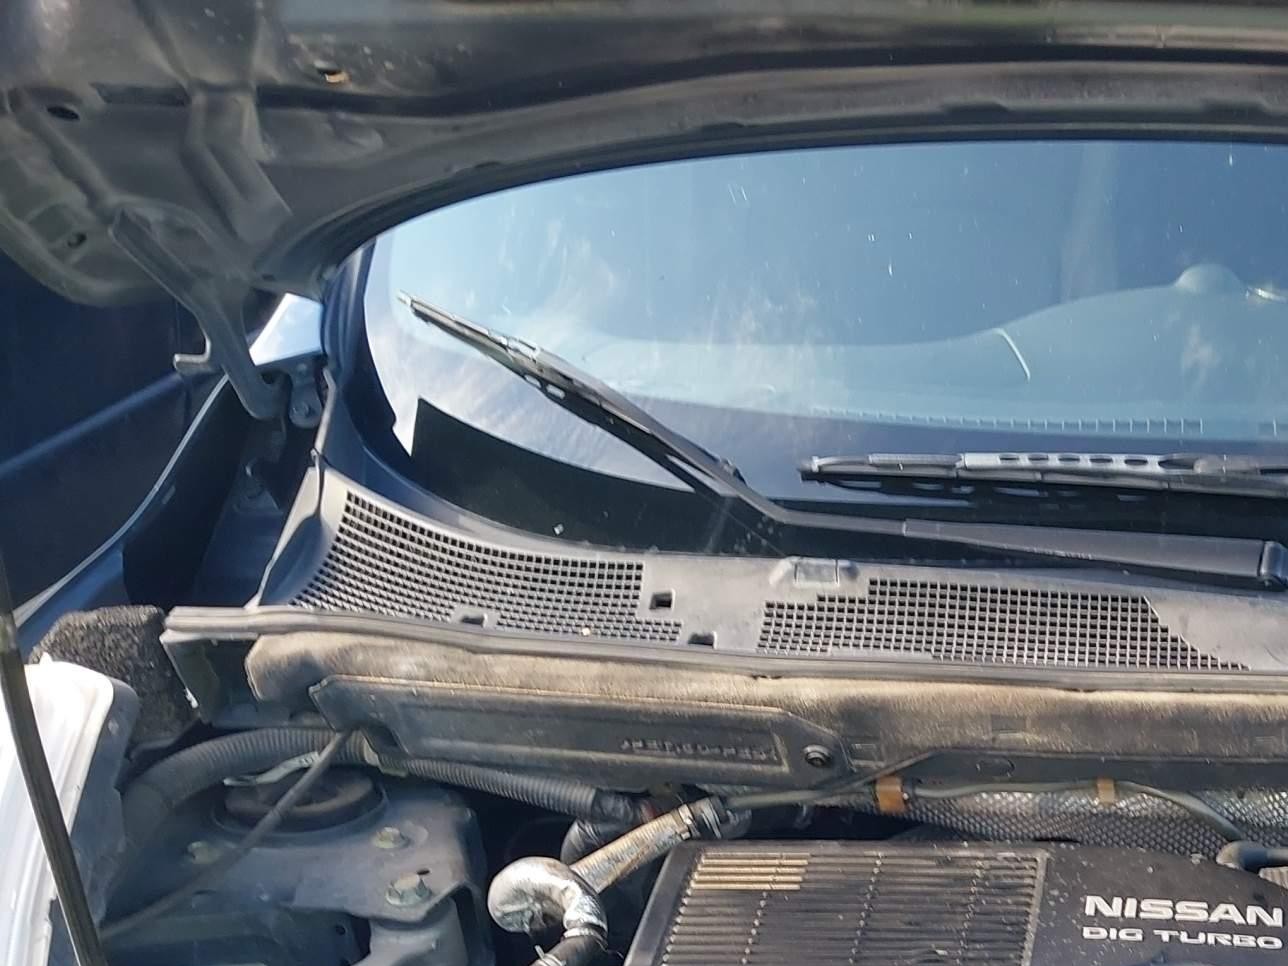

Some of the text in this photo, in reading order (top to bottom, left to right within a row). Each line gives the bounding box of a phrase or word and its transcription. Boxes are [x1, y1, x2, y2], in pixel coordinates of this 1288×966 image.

[1085, 896, 1283, 928] NISSAN
[1082, 927, 1283, 950] DIG TURBO
